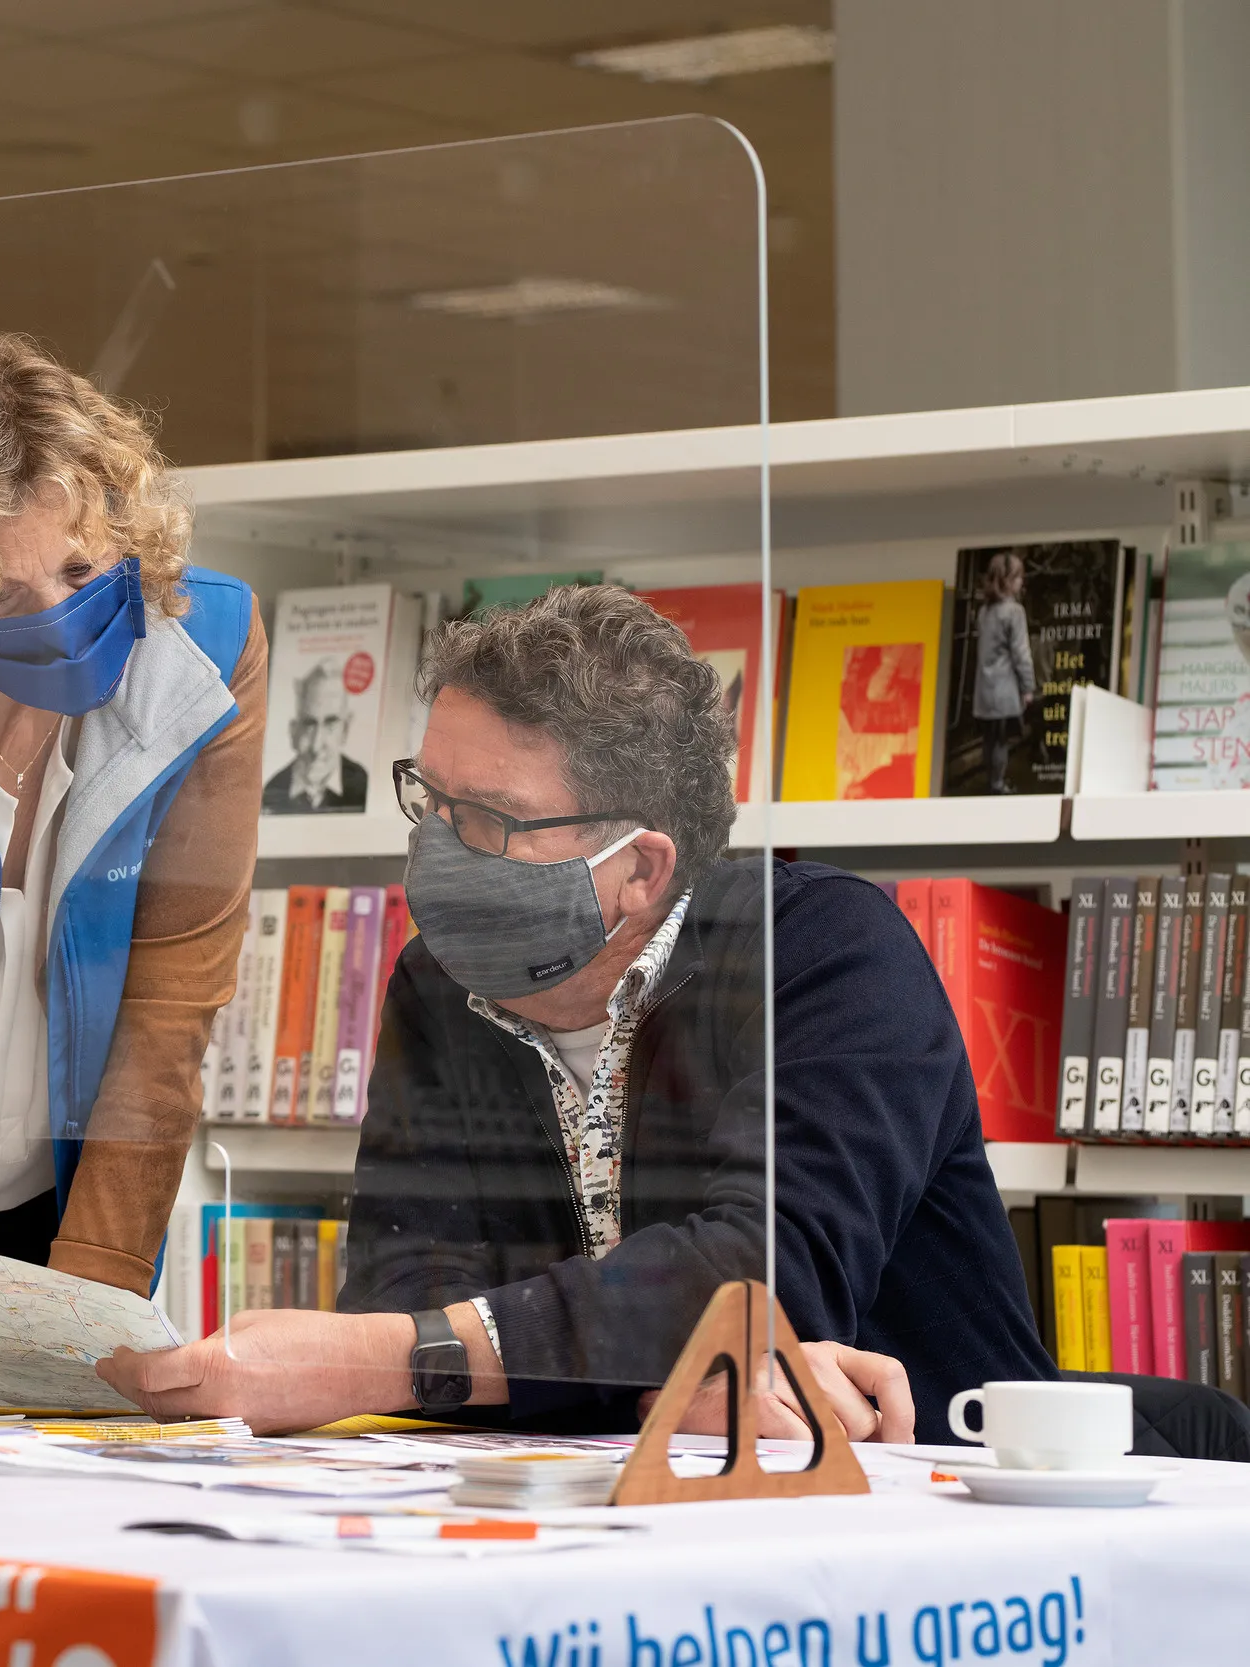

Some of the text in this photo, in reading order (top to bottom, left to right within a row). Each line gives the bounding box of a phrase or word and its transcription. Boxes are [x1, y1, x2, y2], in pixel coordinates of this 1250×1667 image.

[1053, 602, 1093, 618] IRMA
[1040, 623, 1103, 643] JOUBERT
[1055, 652, 1085, 669] Het
[1178, 706, 1235, 734] STAP
[1045, 731, 1068, 748] tre
[107, 866, 127, 881] OV
[1078, 893, 1097, 908] XL
[1112, 893, 1131, 909] XL
[1137, 892, 1156, 908] XL
[1162, 892, 1183, 908] XL
[1186, 891, 1203, 907] XL
[1209, 891, 1228, 908] XL
[1231, 890, 1248, 907] XL
[1190, 1269, 1211, 1285] XL
[1221, 1270, 1241, 1286] XL
[858, 1611, 890, 1667] u
[913, 1575, 1088, 1667] graag!
